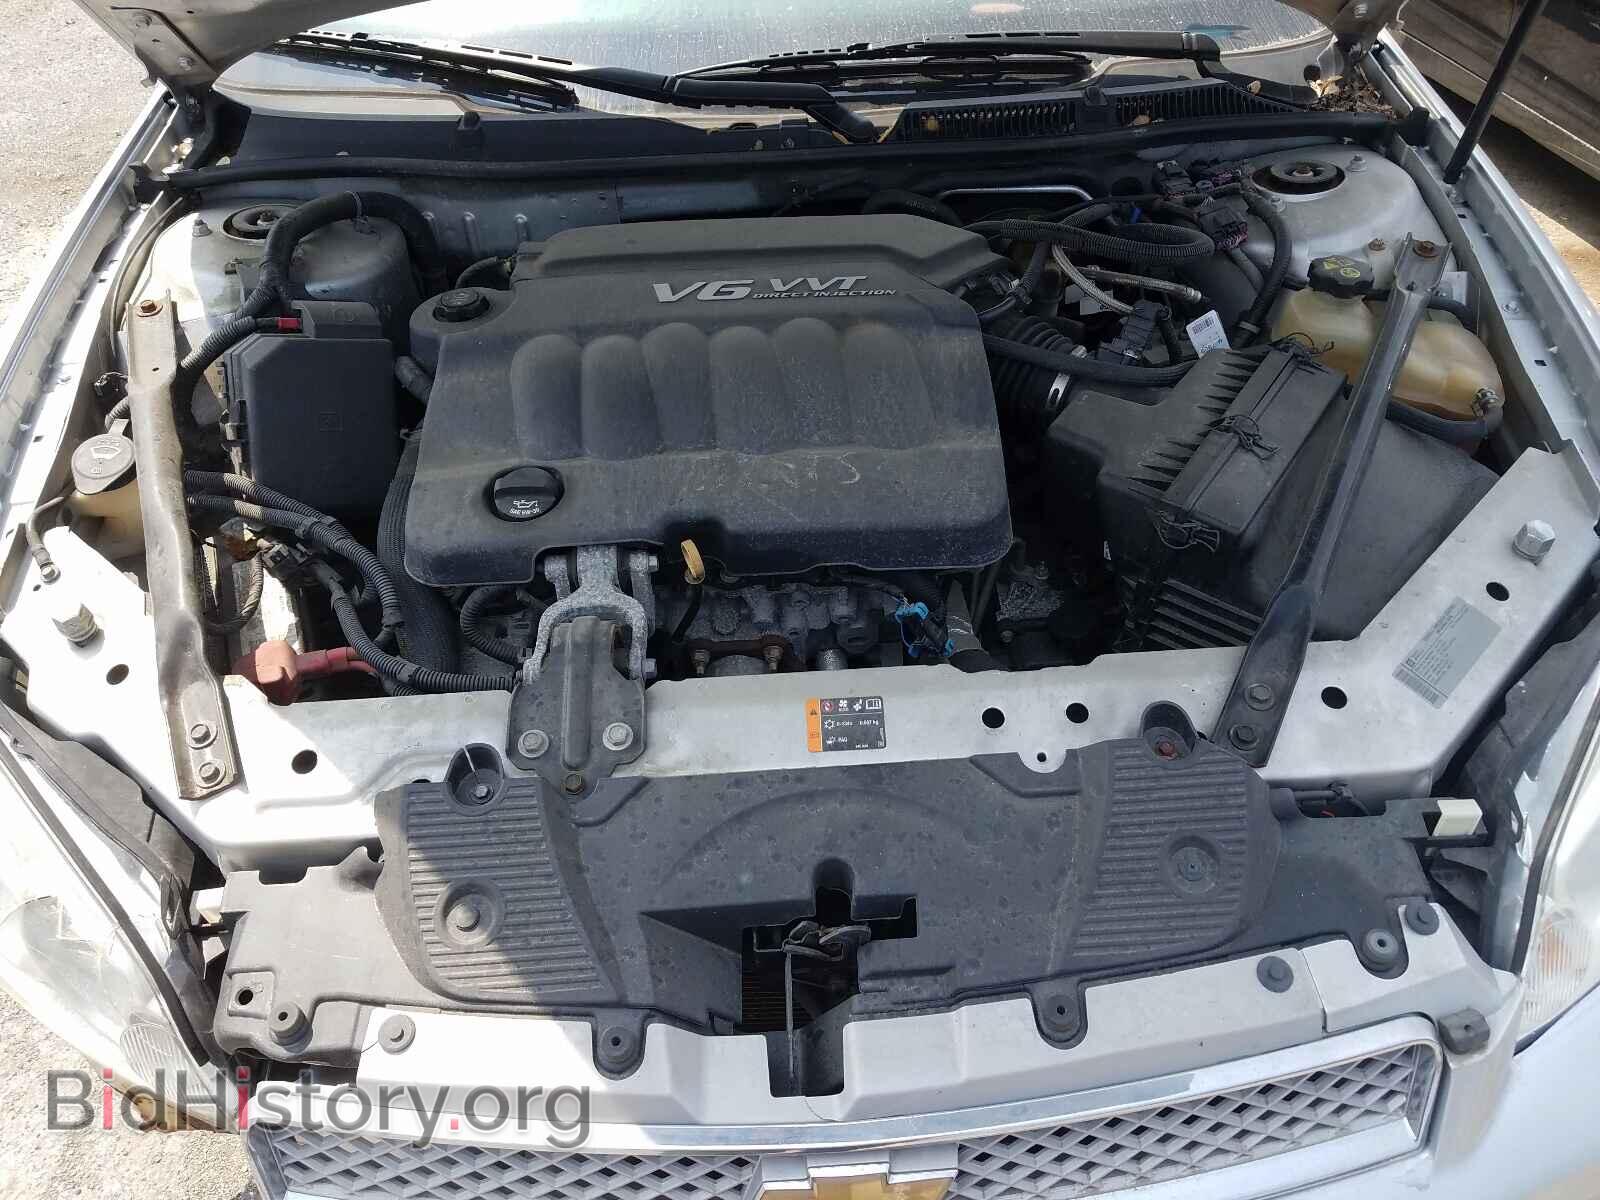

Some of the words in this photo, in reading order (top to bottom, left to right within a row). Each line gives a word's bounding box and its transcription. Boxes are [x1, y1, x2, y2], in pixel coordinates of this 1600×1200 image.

[653, 279, 755, 302] V6
[769, 275, 868, 292] VVT
[752, 290, 812, 299] DIRECT
[813, 289, 897, 297] INJECTION
